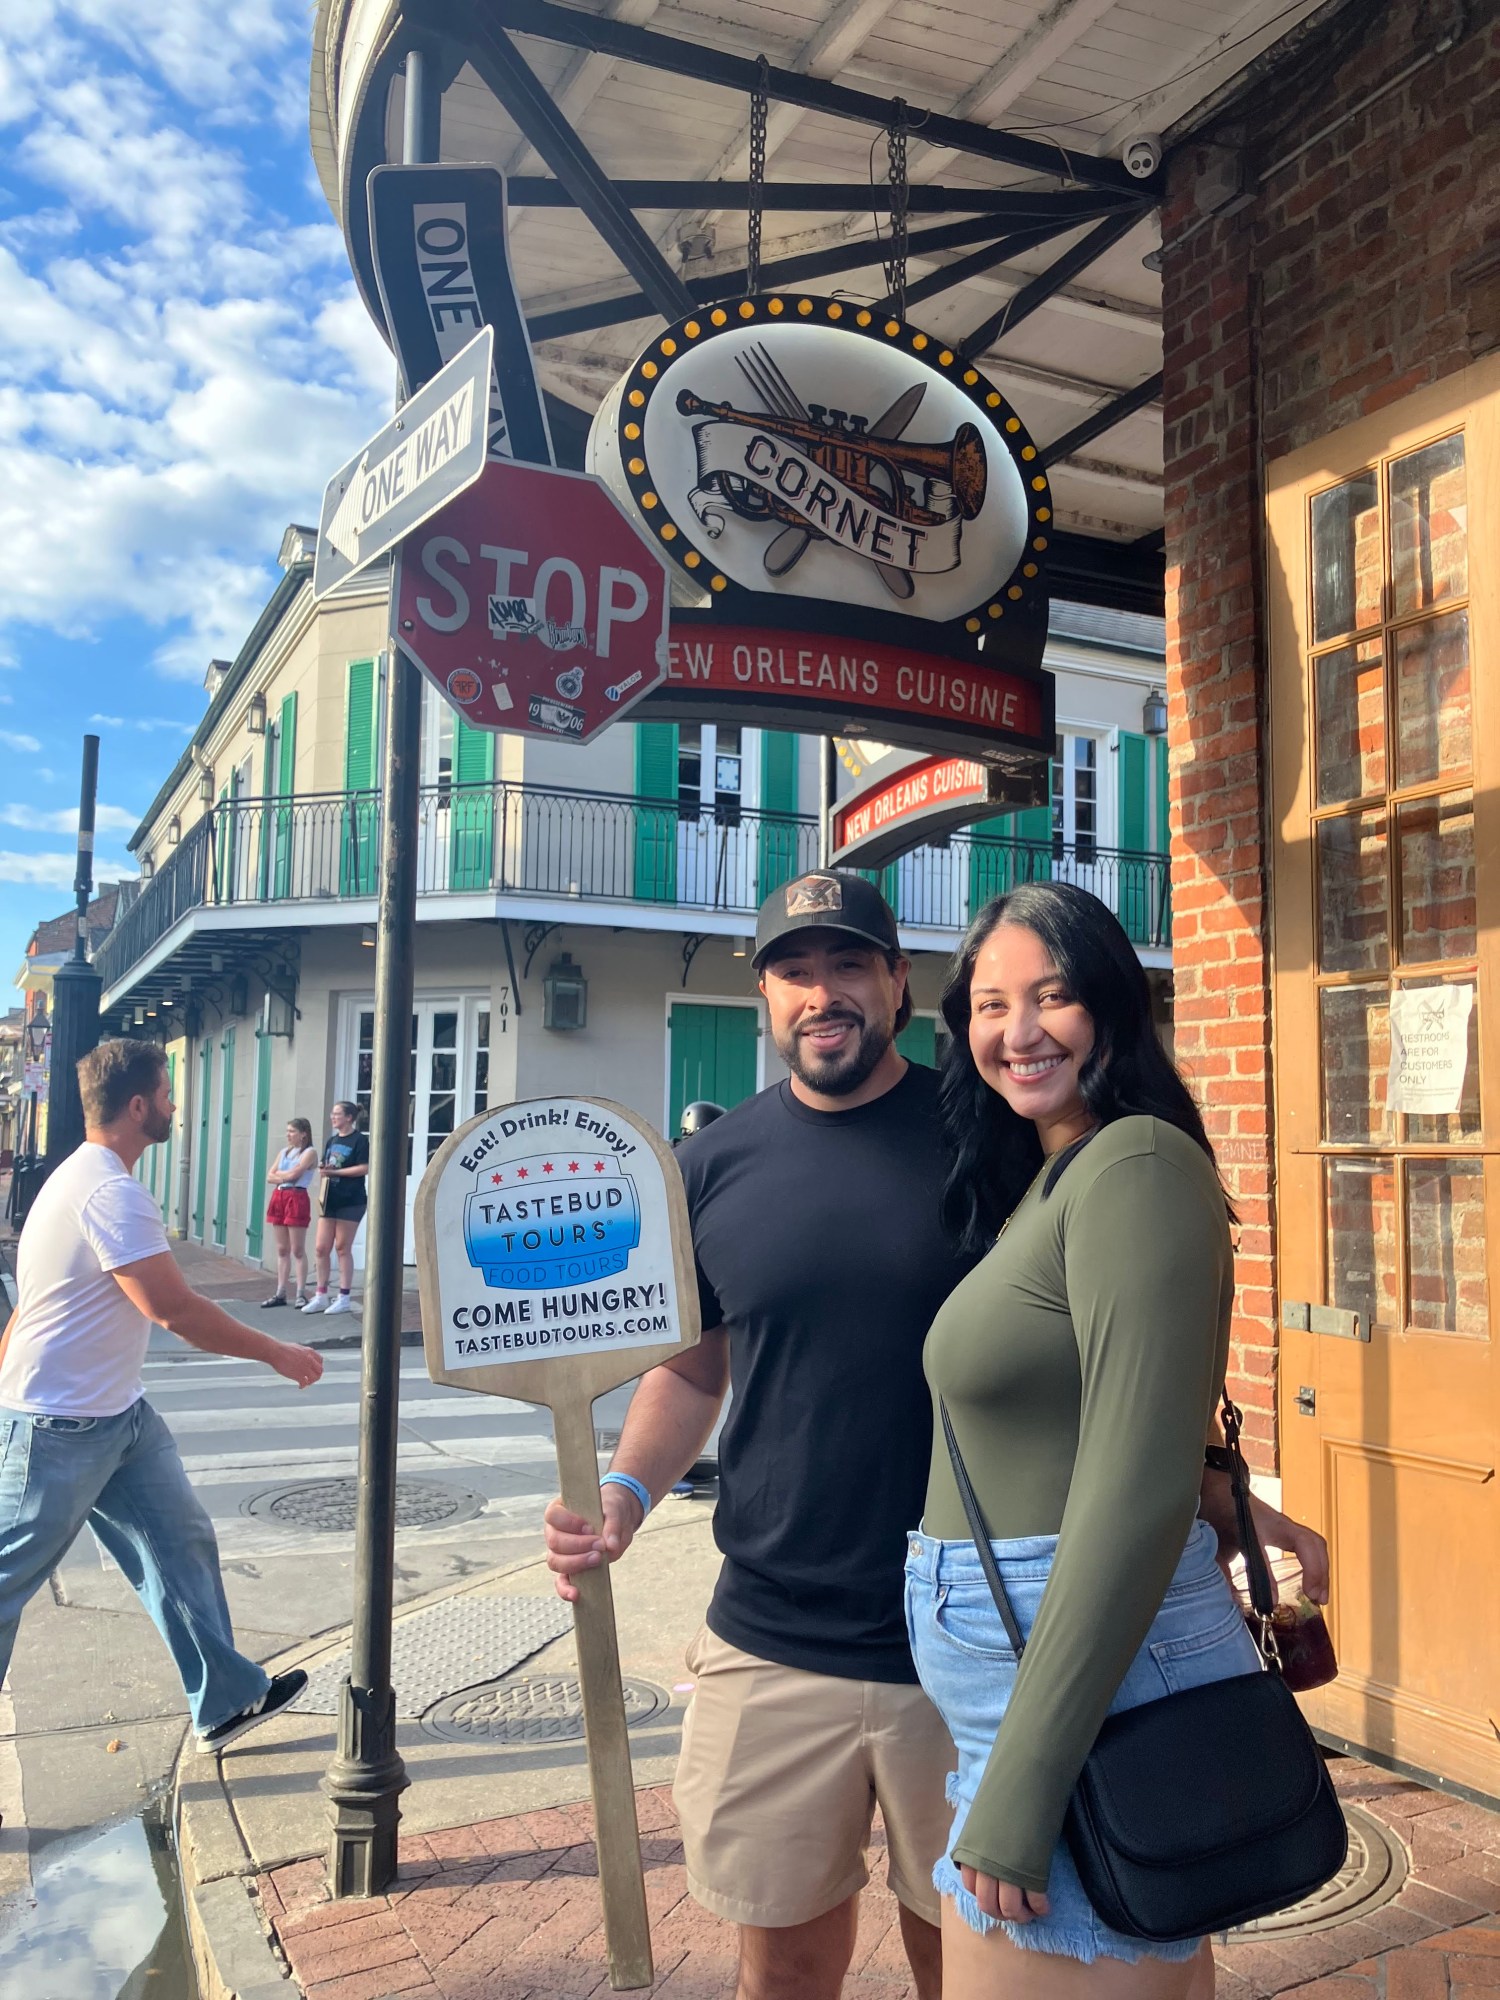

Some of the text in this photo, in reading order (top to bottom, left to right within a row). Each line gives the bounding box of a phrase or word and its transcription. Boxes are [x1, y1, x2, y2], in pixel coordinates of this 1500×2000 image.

[417, 218, 483, 332] ONE
[362, 446, 408, 523] ONE
[416, 390, 468, 481] WAY
[744, 435, 928, 569] CORNET
[416, 536, 648, 658] STOP
[668, 642, 1018, 728] EW ORLEANS CUISINE
[570, 716, 584, 731] 06
[846, 808, 870, 843] NEW
[874, 774, 928, 825] ORLEANS
[500, 987, 509, 1033] 701
[1400, 1032, 1450, 1043] RESTROOMS
[1400, 1047, 1439, 1057] ARE FOR
[1399, 1074, 1427, 1085] ONLY
[1400, 1060, 1453, 1071] CUSTOMERS
[460, 1109, 637, 1173] Eat! Drink! Enjoy!
[479, 1188, 622, 1224] TASTEBUD
[489, 1253, 624, 1284] FOOD TOURS
[452, 1282, 666, 1329] COME HUNGRY!
[455, 1315, 668, 1354] TASTEBUDTOURS.COM
